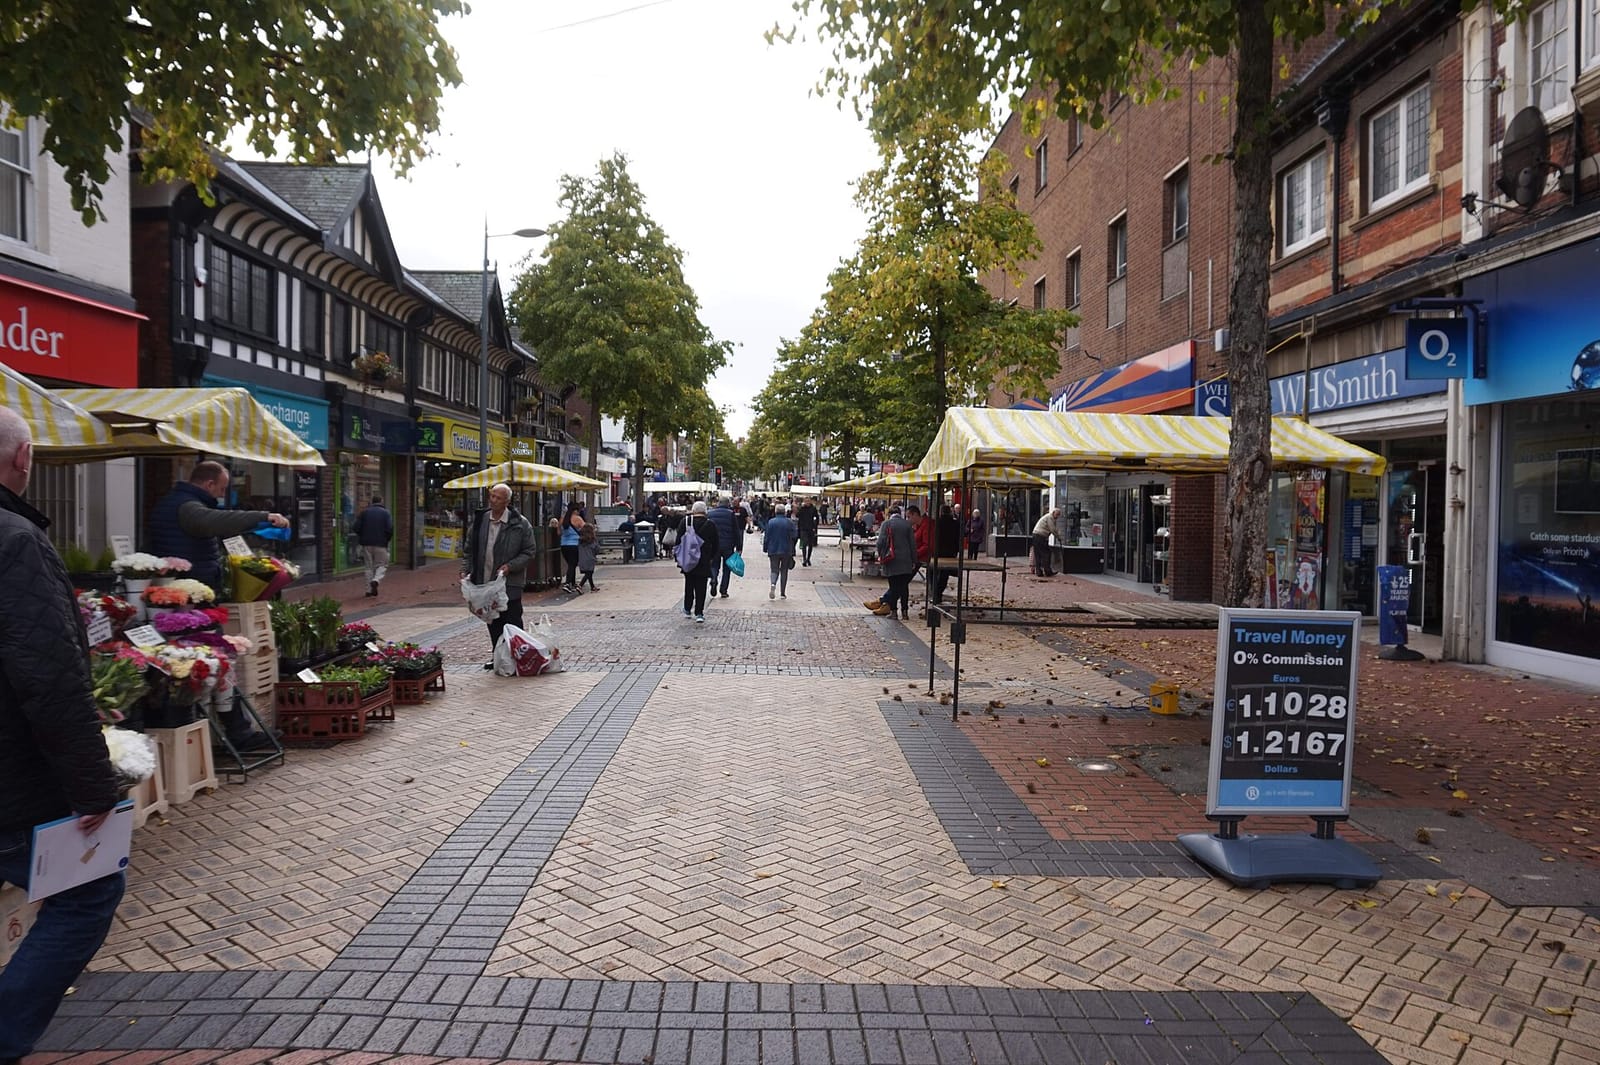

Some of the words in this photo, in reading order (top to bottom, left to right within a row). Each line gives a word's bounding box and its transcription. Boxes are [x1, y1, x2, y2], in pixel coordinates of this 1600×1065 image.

[1204, 383, 1227, 396] WH
[1278, 355, 1398, 415] WHSmith
[262, 402, 310, 428] change
[1530, 532, 1549, 541] Catch
[1550, 533, 1570, 542] some
[1234, 628, 1287, 643] Travel
[1291, 630, 1346, 648] Money
[1233, 650, 1259, 665] 0%
[1262, 653, 1344, 666] Commission
[1273, 674, 1300, 683] Euros
[1239, 691, 1347, 719] 1.1028
[1236, 731, 1345, 756] 1.2167
[1264, 765, 1299, 773] Dollars
